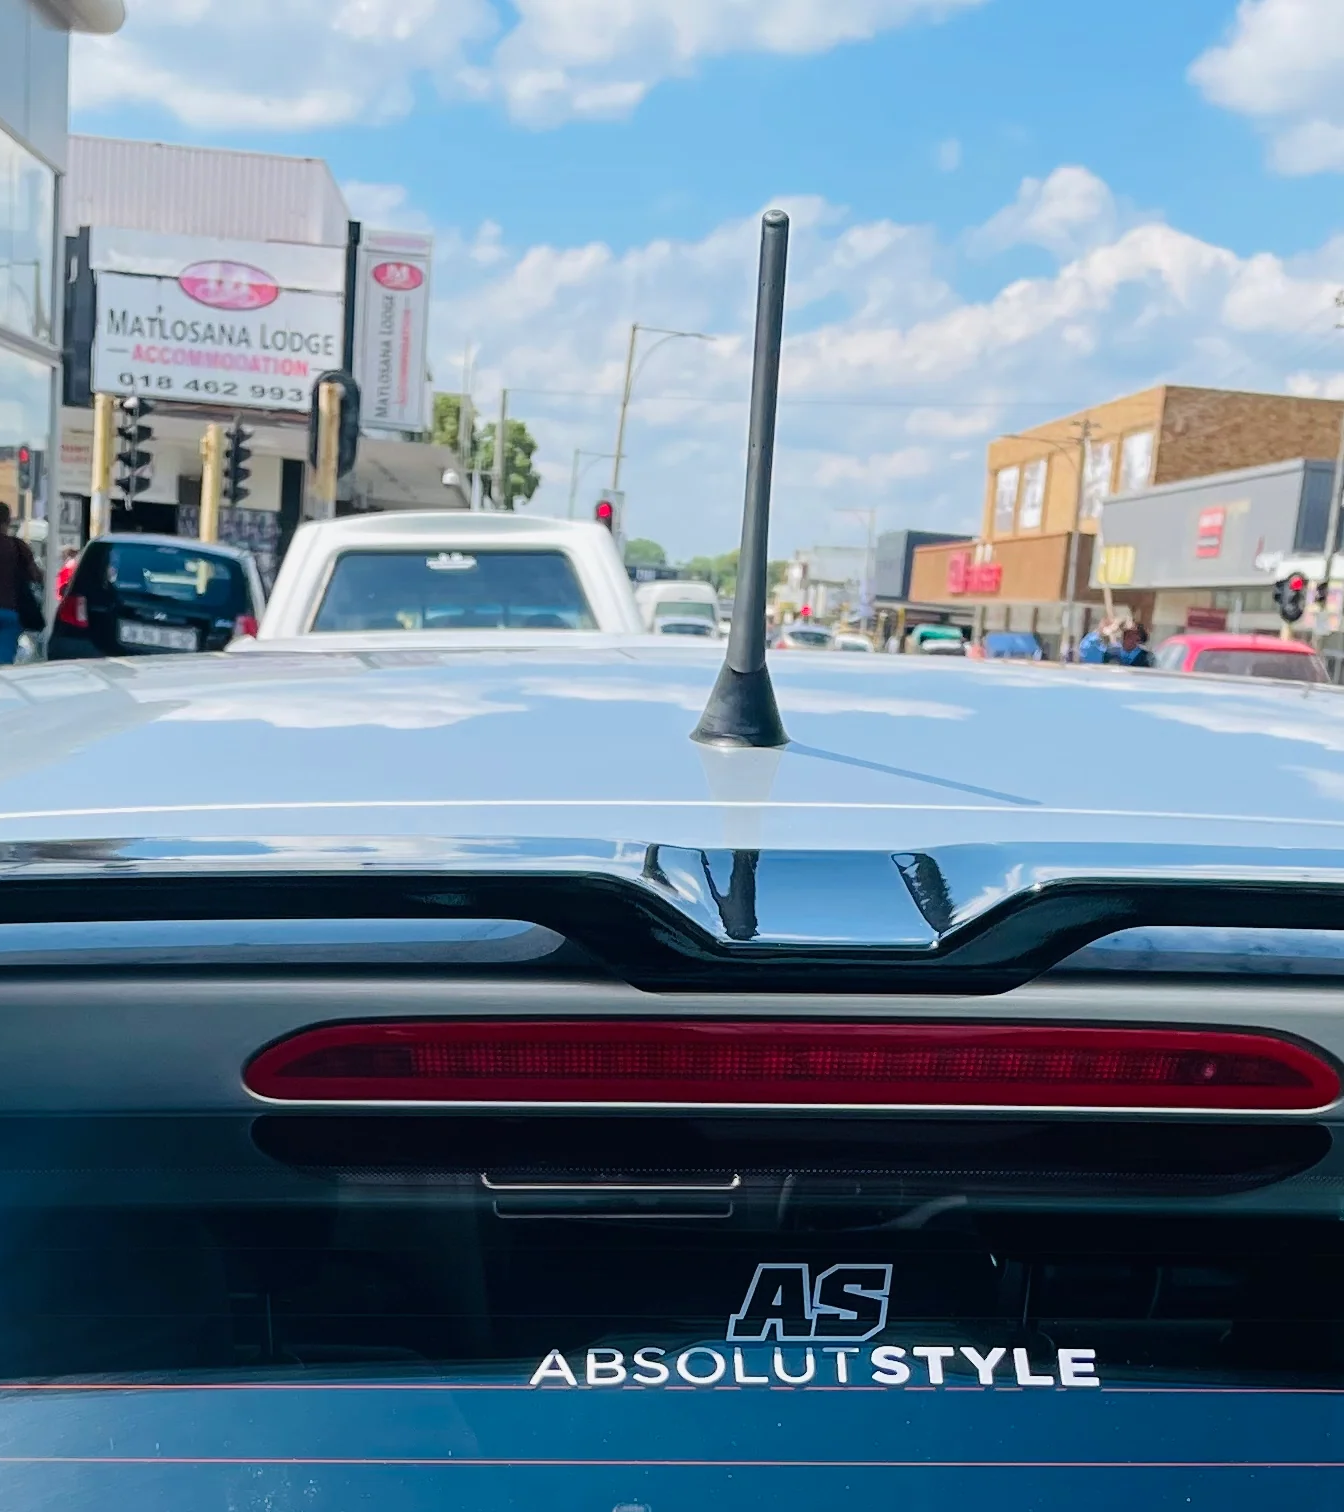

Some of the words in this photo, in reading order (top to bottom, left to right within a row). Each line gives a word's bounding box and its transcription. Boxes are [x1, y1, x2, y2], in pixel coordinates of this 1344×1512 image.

[107, 307, 251, 348] MATLOSANA
[259, 323, 335, 356] LODGE
[131, 344, 310, 377] ACCOMMODATION
[119, 372, 174, 389] 018
[184, 379, 239, 397] 462
[249, 384, 312, 402] 993
[725, 1263, 894, 1343] AS
[528, 1345, 1102, 1388] ABSOLUTSTYLE
